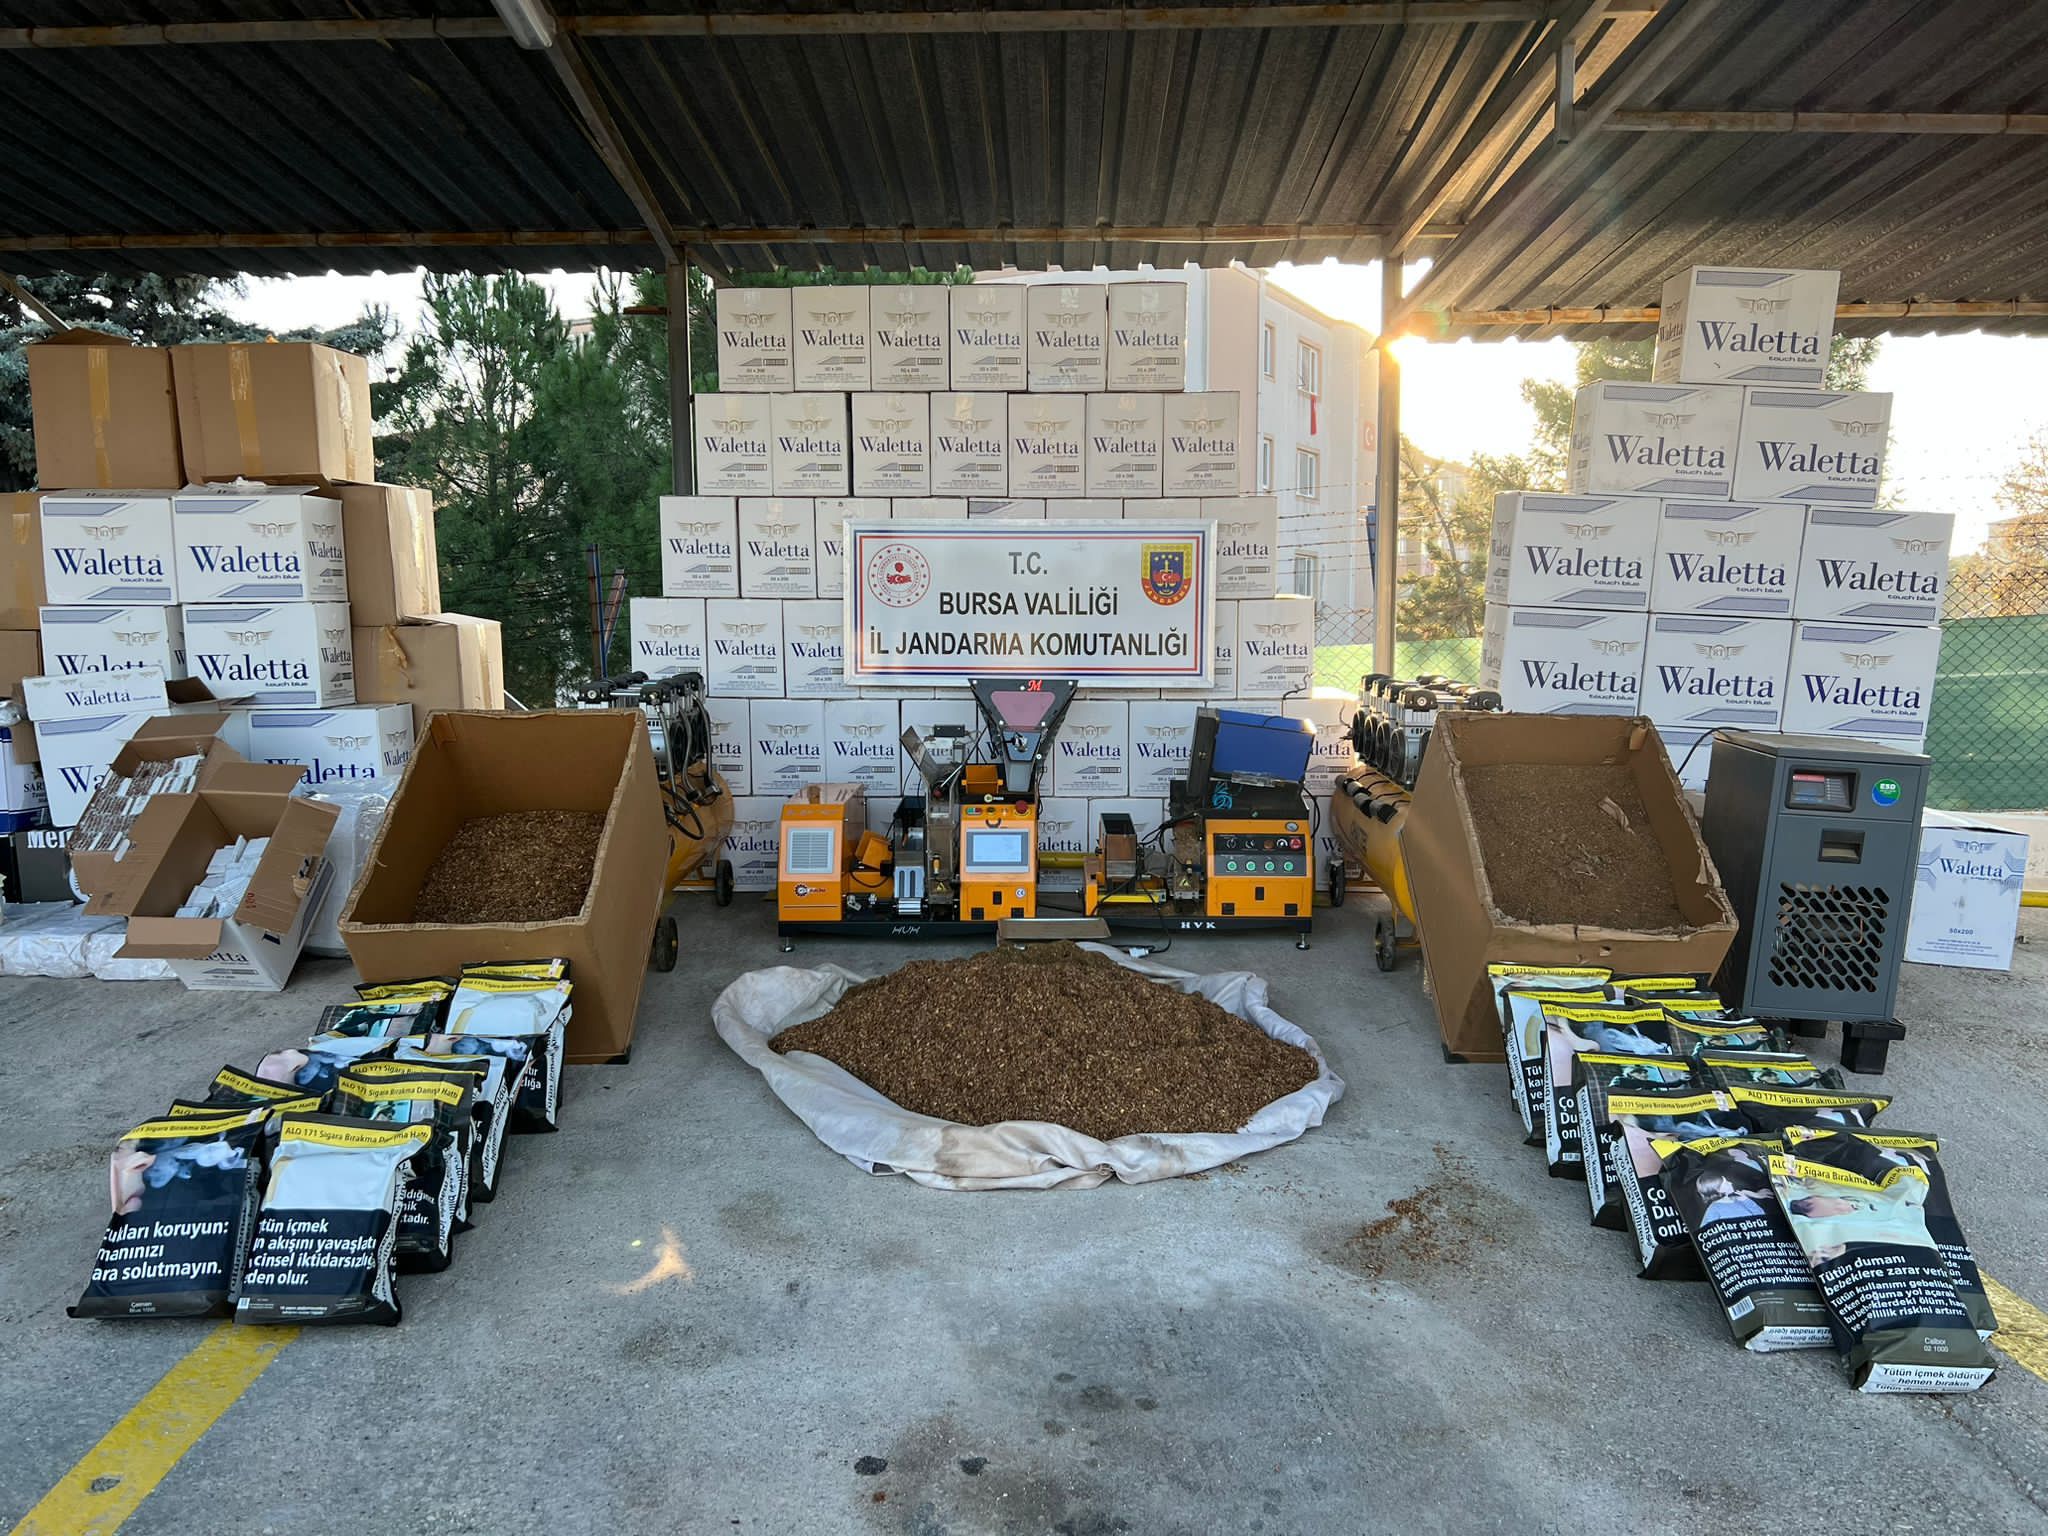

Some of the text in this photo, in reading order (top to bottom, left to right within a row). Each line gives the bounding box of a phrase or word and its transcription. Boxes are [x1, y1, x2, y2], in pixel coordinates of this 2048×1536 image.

[723, 330, 786, 348] Waletta
[802, 329, 864, 346] Waletta
[878, 330, 941, 348] Waletta
[958, 328, 1020, 346] Waletta
[1036, 330, 1100, 348] Waletta
[1115, 329, 1178, 346] Waletta
[1696, 320, 1820, 355] Waletta
[704, 436, 766, 453] Waletta
[779, 436, 841, 453] Waletta
[860, 436, 922, 453] Waletta
[938, 436, 1001, 453] Waletta
[1016, 438, 1078, 455] Waletta
[1094, 436, 1156, 453] Waletta
[1172, 436, 1234, 454] Waletta
[1604, 434, 1725, 469] Waletta
[1756, 440, 1879, 476] Waletta
[308, 540, 343, 560] Waletta
[670, 538, 730, 555] Waletta
[748, 541, 809, 558] Waletta
[51, 547, 164, 577] Waletta
[188, 545, 301, 573] Waletta
[1013, 550, 1052, 574] T.C.
[1524, 545, 1643, 580] Waletta
[1666, 552, 1786, 586] Waletta
[1816, 559, 1938, 594] Waletta
[939, 584, 1118, 616] BURSA VALİLİĞİ
[638, 640, 700, 657] Waletta
[715, 640, 776, 656] Waletta
[870, 626, 889, 655] İL
[895, 632, 1024, 656] JANDARMA
[1031, 627, 1188, 656] KOMUTANLIĞI
[1246, 640, 1308, 656] Waletta
[320, 647, 352, 664] Waletta
[195, 654, 309, 681] Waletta
[1520, 659, 1638, 694] Waletta
[1656, 665, 1774, 699] Waletta
[64, 690, 130, 708] Waletta
[1801, 674, 1920, 709] Waletta
[759, 740, 820, 756] Waletta
[833, 740, 894, 756] Waletta
[1060, 741, 1120, 757] Waletta
[1940, 858, 2002, 878] Waletta
[1748, 1090, 1838, 1106] ALO 171 Sigara Bırakma
[284, 1128, 378, 1144] ALO 171 Sigara Bırakma
[1804, 1168, 1831, 1180] Sigara
[1832, 1171, 1868, 1185] Bırakma
[1652, 1205, 1679, 1220] Du
[154, 1220, 229, 1239] koruyun:
[286, 1218, 328, 1236] içmek
[1698, 1218, 1768, 1243] Çocuklar görür
[268, 1235, 314, 1254] akışını
[1702, 1229, 1774, 1253] Çocuklar yapar
[254, 1252, 294, 1267] cinsel
[1707, 1248, 1728, 1264] Tütün
[1712, 1258, 1731, 1272] tütün
[1732, 1252, 1754, 1264] içme
[122, 1260, 222, 1280] solutmayın.
[1715, 1258, 1787, 1280] Yaşam boyu tütün
[1720, 1274, 1740, 1289] erken
[1740, 1266, 1784, 1278] ölümlerin
[1818, 1254, 1906, 1286] Tütün dumanı
[278, 1272, 310, 1286] olur.
[1724, 1278, 1760, 1298] içmekten
[1824, 1266, 1948, 1296] bebeklere zarar verir
[1830, 1290, 1856, 1308] Tütün
[1856, 1280, 1906, 1294] kullanımı
[1909, 1278, 1954, 1290] gebelikte
[1839, 1300, 1860, 1316] erken
[1860, 1291, 1903, 1303] doğuma
[1905, 1288, 1923, 1298] yol
[1924, 1288, 1956, 1299] açarak
[1844, 1297, 1948, 1324] bu ölüm,
[1850, 1306, 1966, 1333] ve riskini artırır.
[1883, 1368, 1984, 1380] Tütün içmek öldürür
